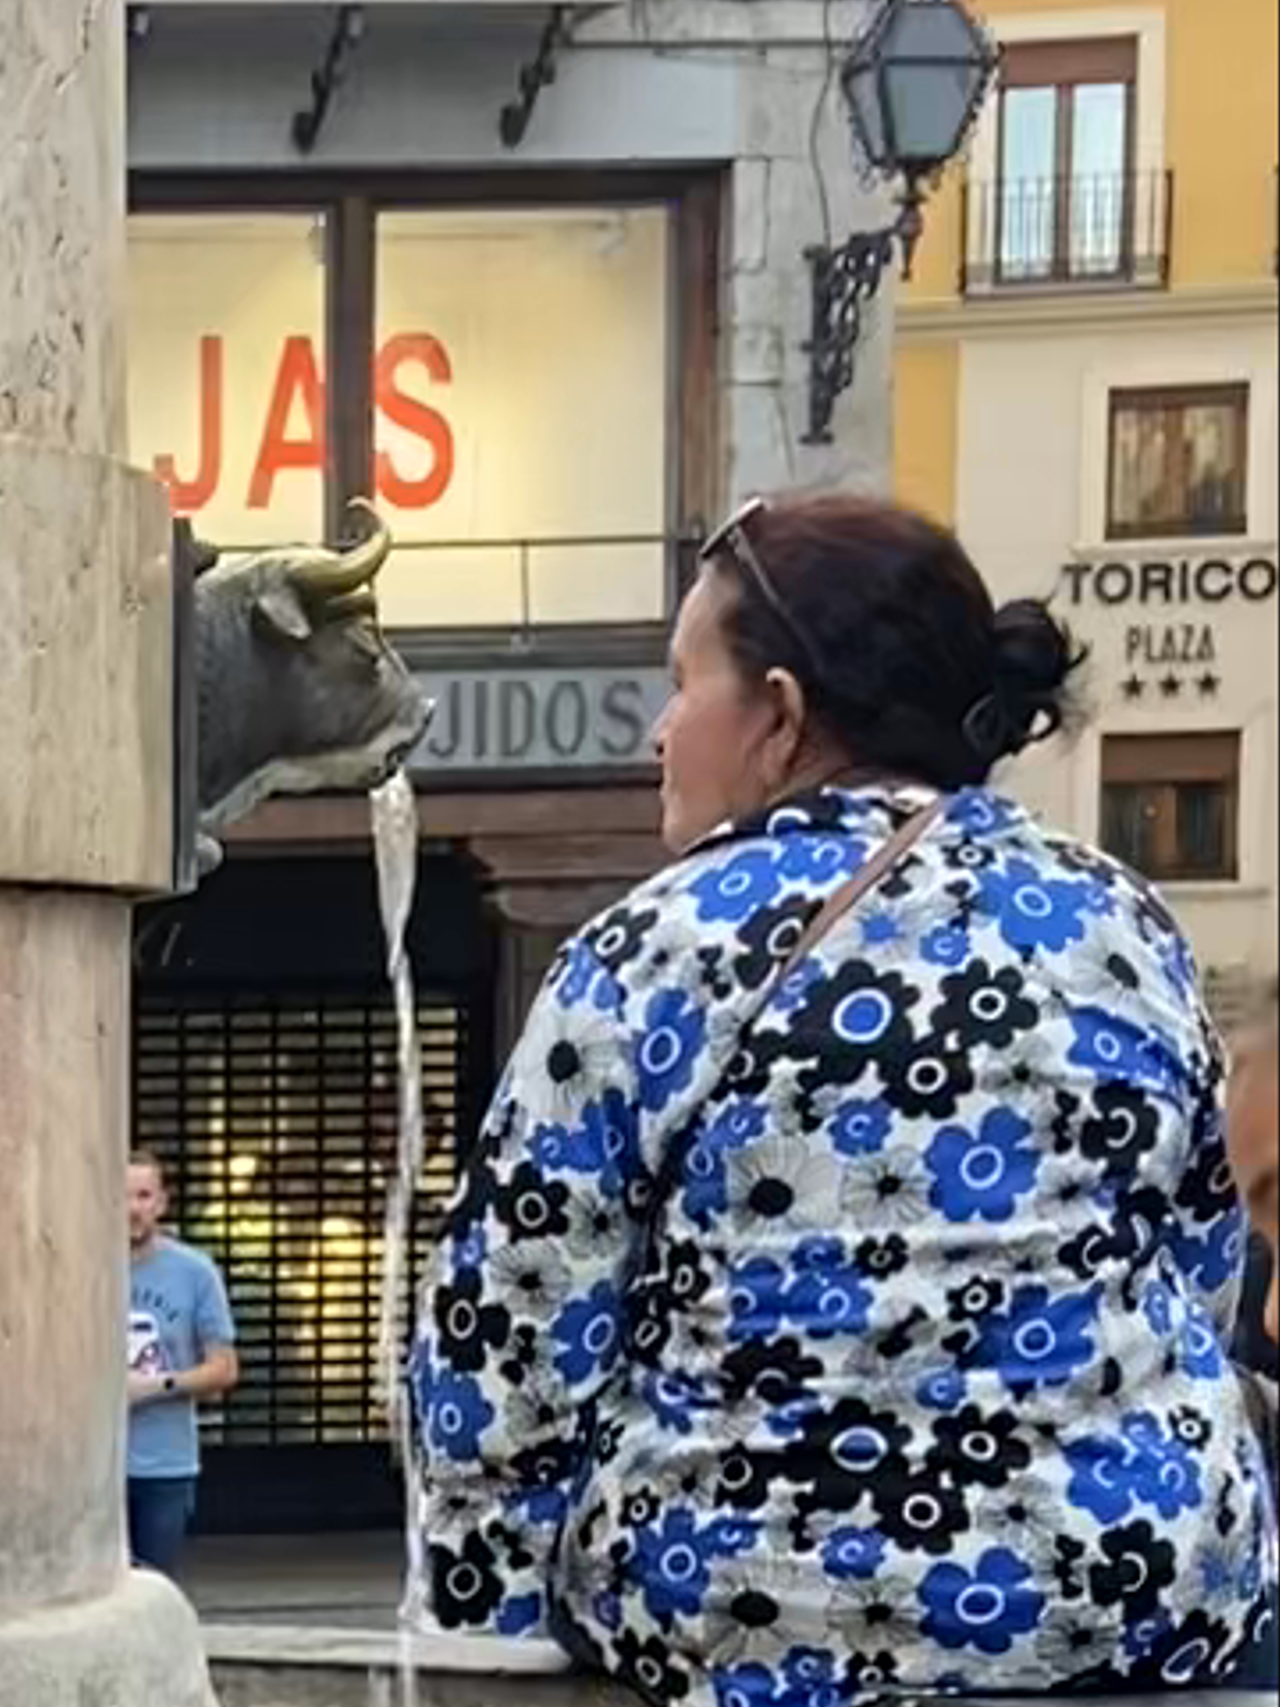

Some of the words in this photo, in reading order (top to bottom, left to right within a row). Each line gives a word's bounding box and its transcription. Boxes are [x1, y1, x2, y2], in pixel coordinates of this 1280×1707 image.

[152, 331, 455, 511] JAS
[1061, 558, 1277, 606] TORICO
[1125, 623, 1216, 665] PLAZA
[427, 679, 644, 759] JIDOS
